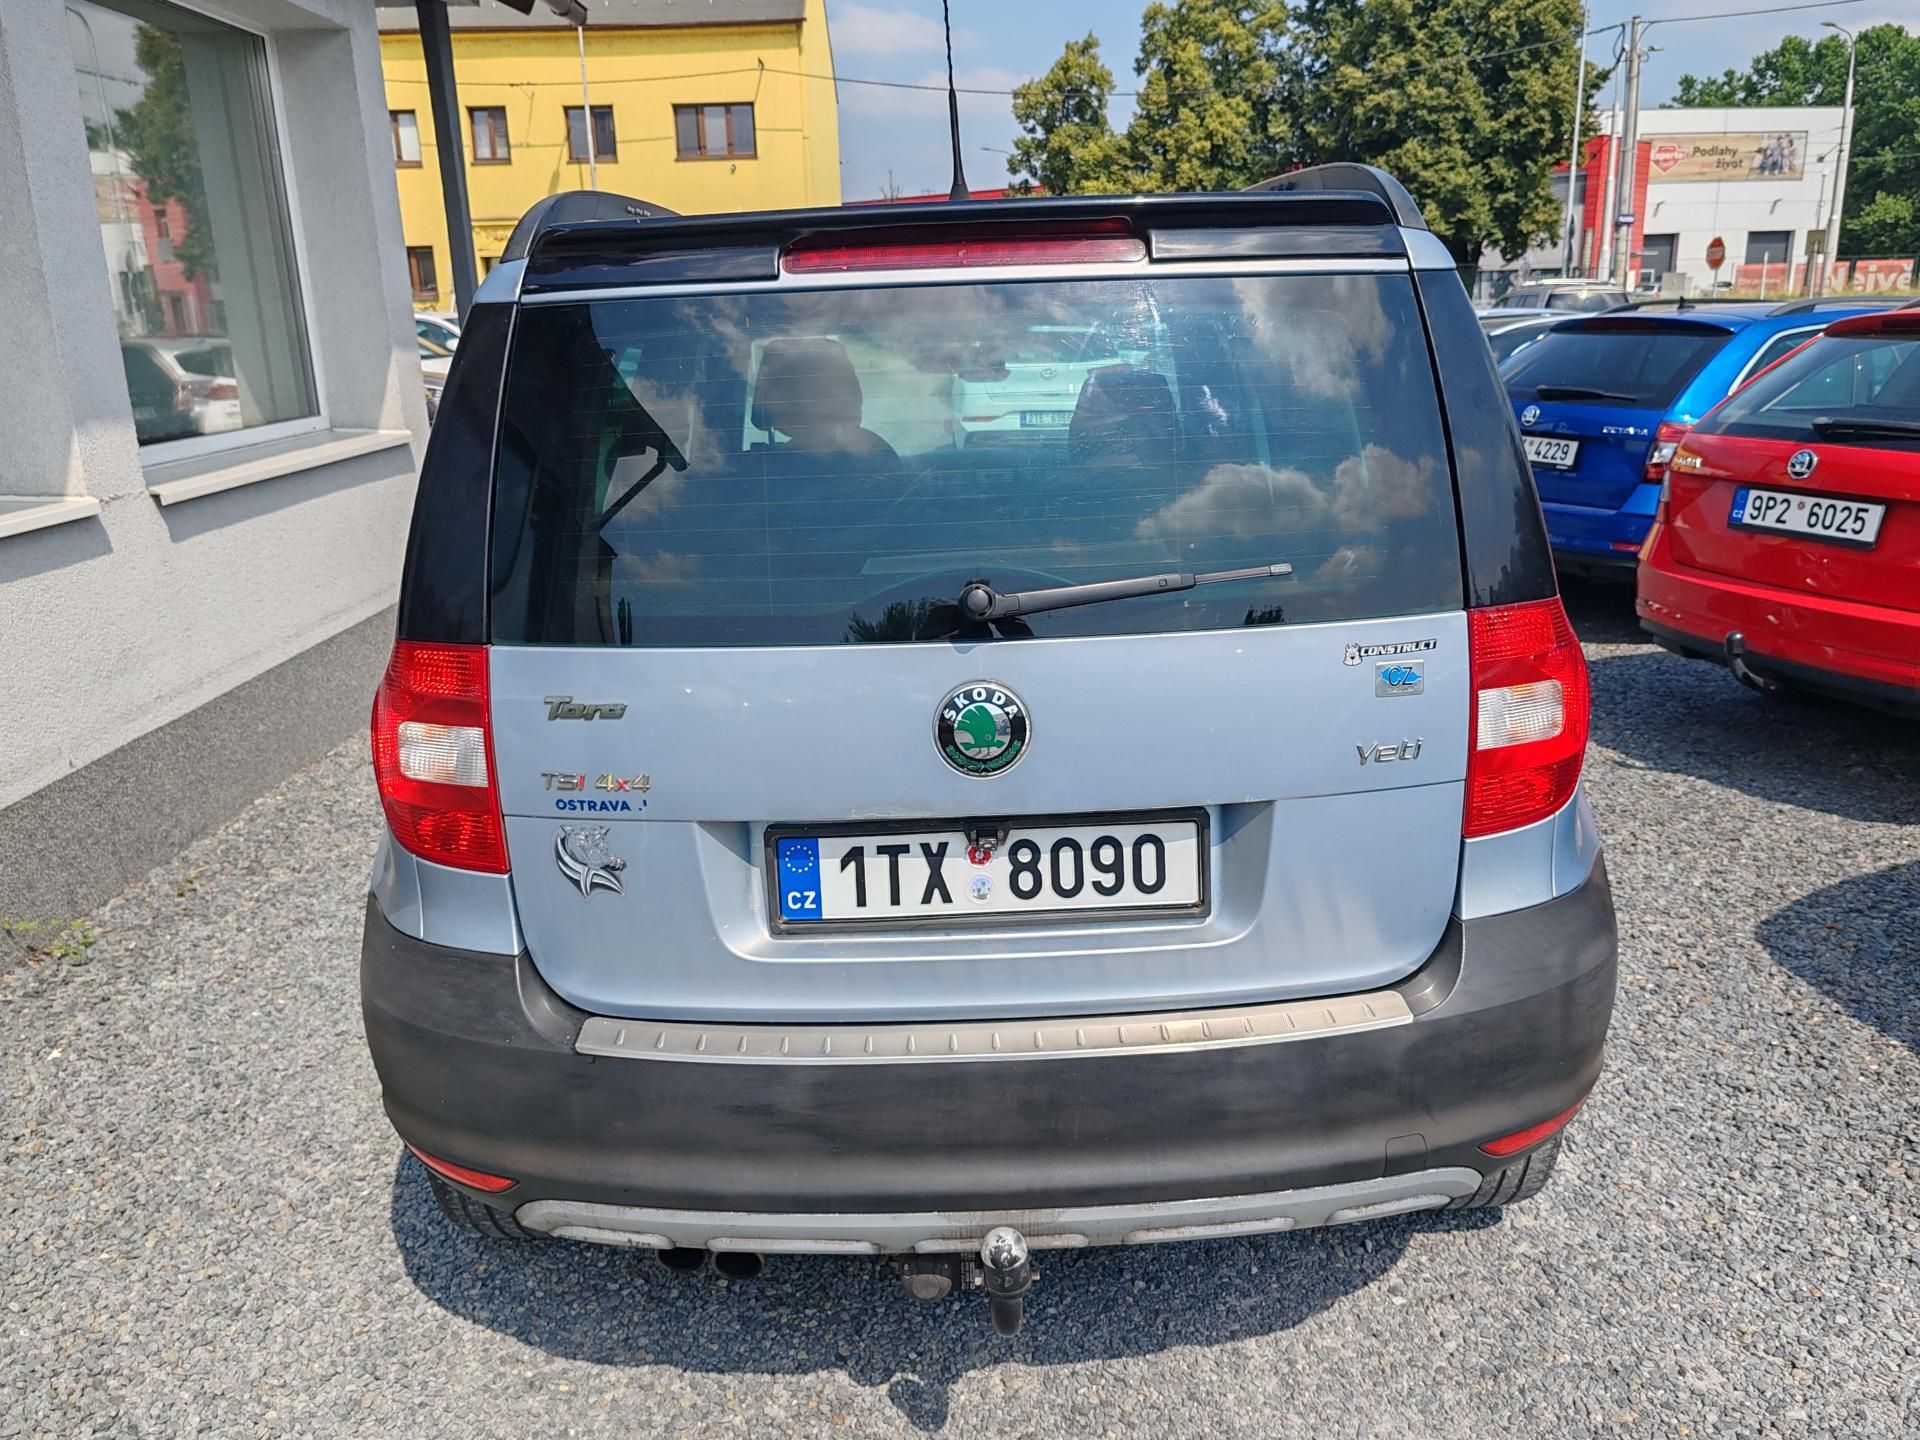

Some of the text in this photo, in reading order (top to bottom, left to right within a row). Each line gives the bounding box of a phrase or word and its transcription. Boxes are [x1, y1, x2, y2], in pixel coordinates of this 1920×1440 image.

[1692, 146, 1738, 158] Podlahy
[1715, 158, 1743, 169] život
[1534, 440, 1570, 461] 4229
[1750, 495, 1869, 535] 9P2 6025
[1360, 640, 1435, 656] CONSTRUCT
[1388, 666, 1413, 687] CZ
[595, 773, 651, 793] 4x4
[556, 799, 631, 812] OSTRAVA
[840, 833, 1166, 908] 1TX 8090
[787, 891, 816, 910] CZ
